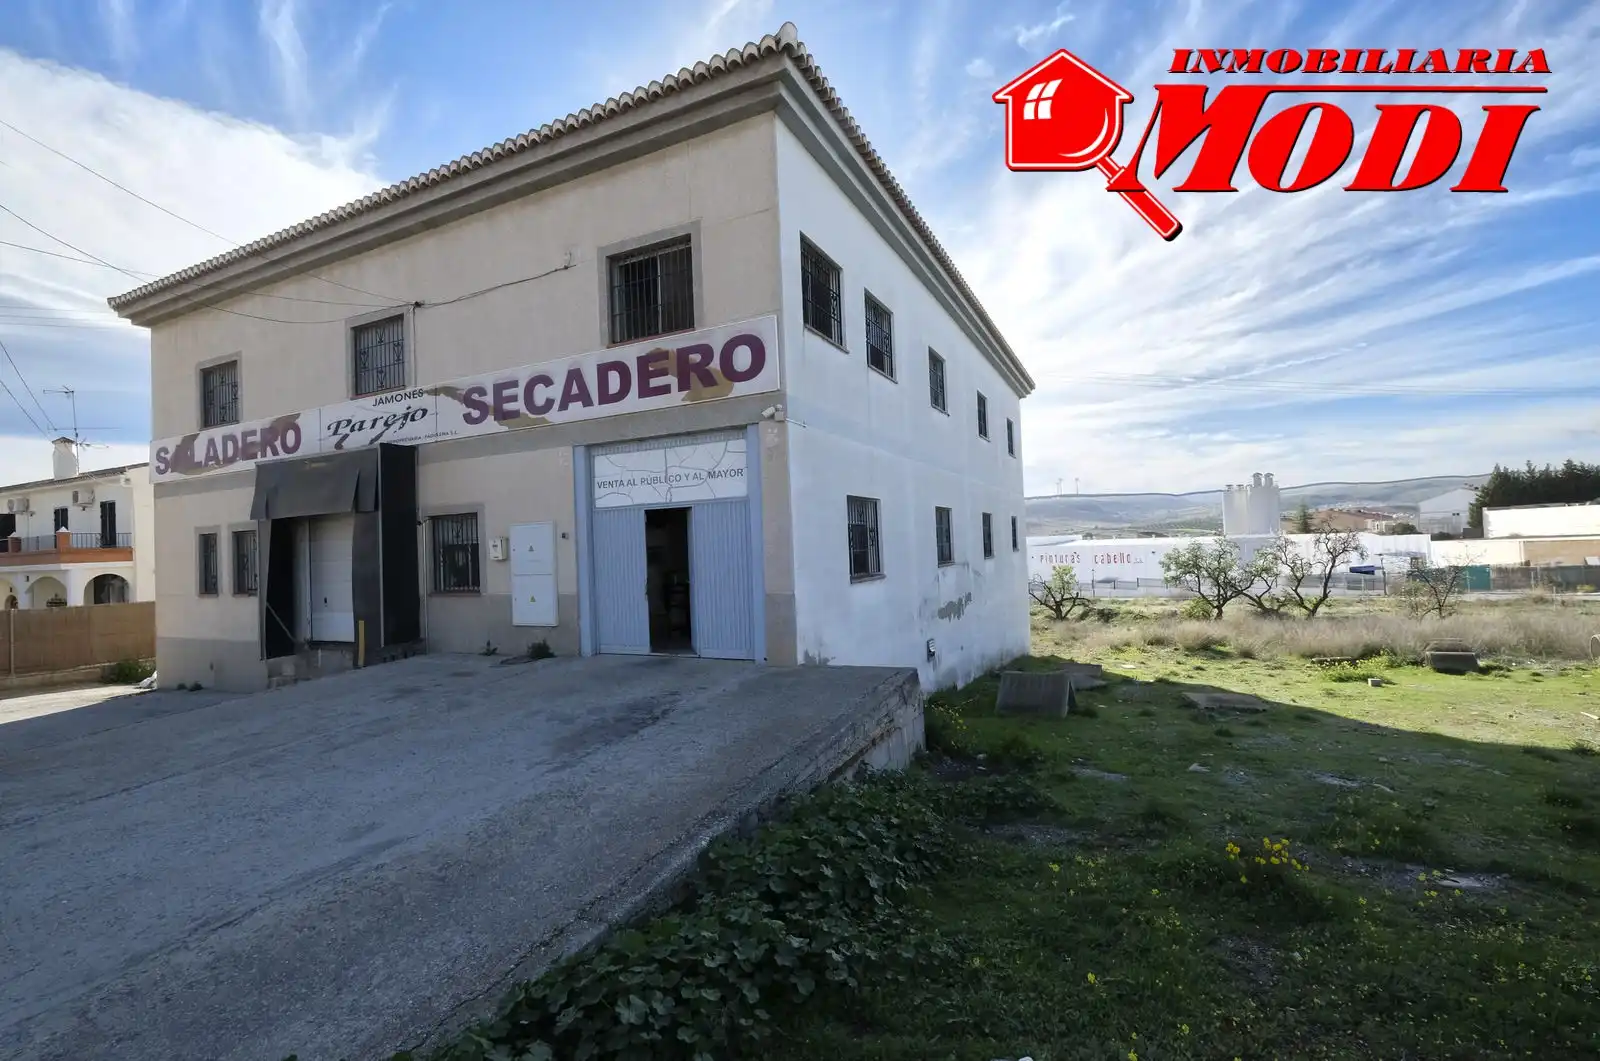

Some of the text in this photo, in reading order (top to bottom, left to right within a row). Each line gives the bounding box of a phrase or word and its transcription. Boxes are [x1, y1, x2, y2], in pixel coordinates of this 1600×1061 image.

[462, 333, 766, 426] SECADERO
[372, 388, 424, 407] JAMONES
[327, 405, 429, 443] Parejo
[597, 479, 625, 489] VENTA
[626, 478, 638, 487] AL
[684, 473, 690, 481] Y
[692, 472, 704, 480] AL
[708, 468, 744, 479] MAYOR
